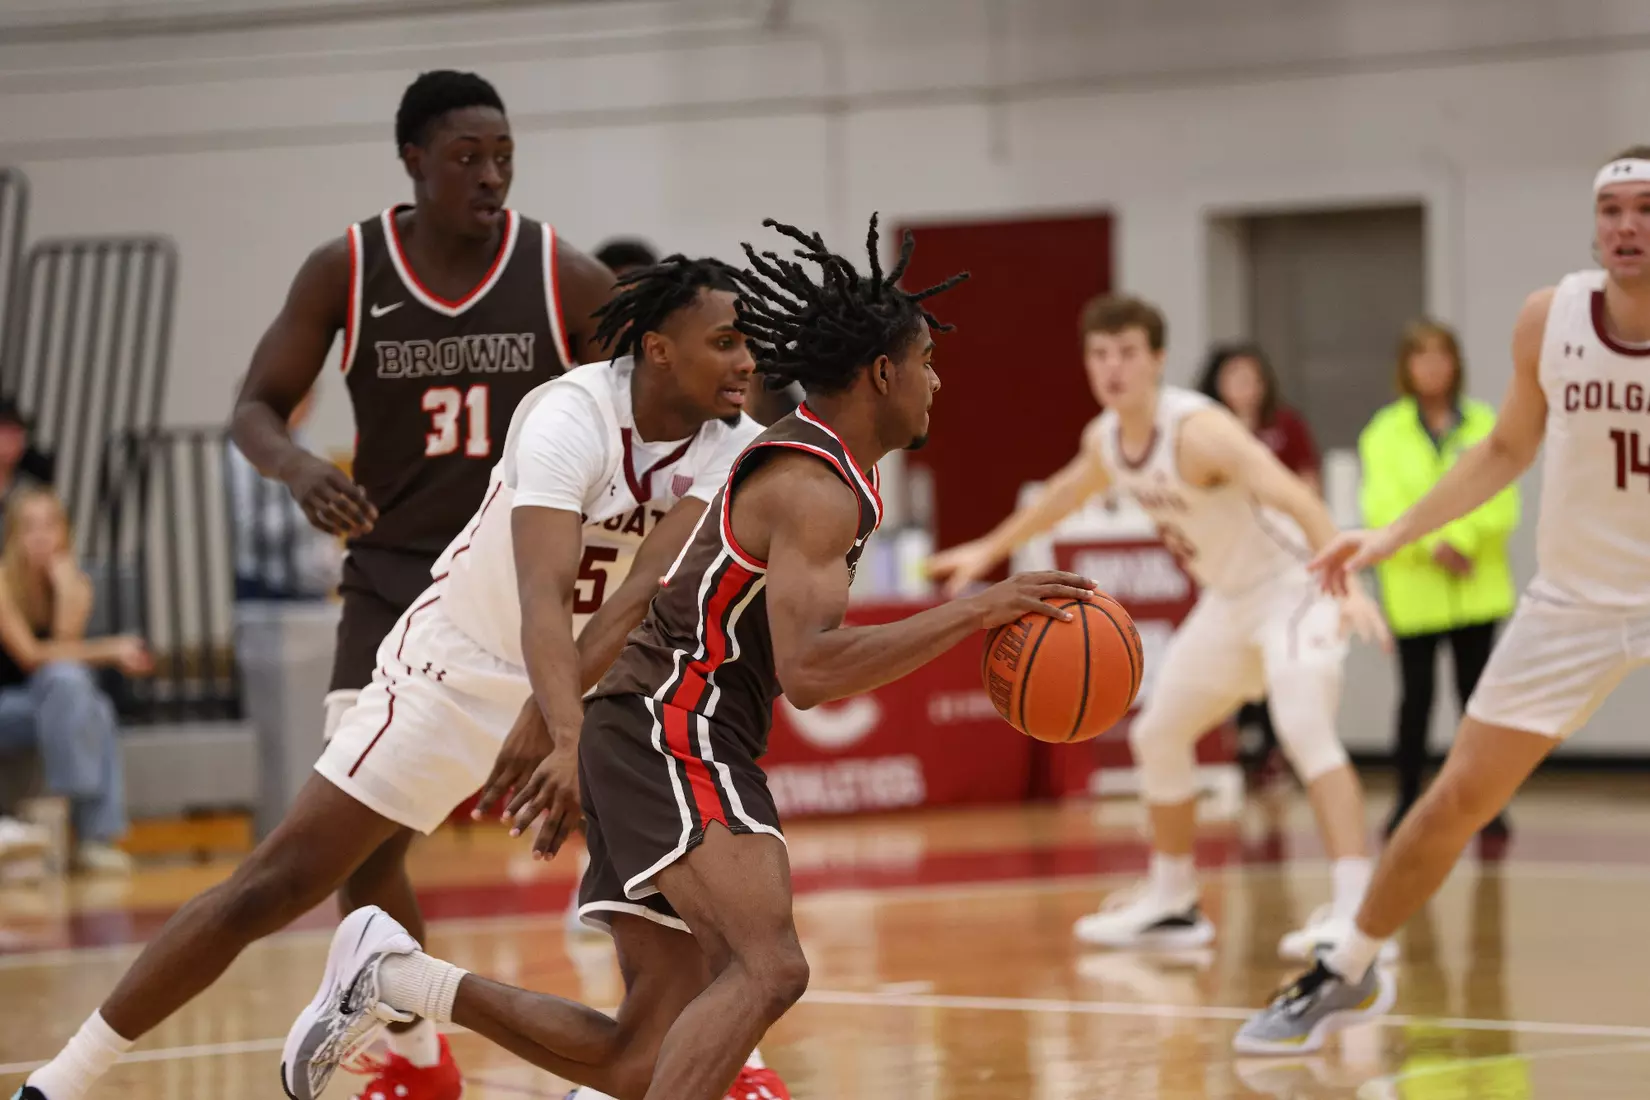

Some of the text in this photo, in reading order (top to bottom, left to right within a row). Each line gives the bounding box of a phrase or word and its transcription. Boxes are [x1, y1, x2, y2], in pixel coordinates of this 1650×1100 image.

[375, 333, 535, 378] BROWN
[1564, 380, 1650, 413] COLG
[421, 383, 491, 458] 31
